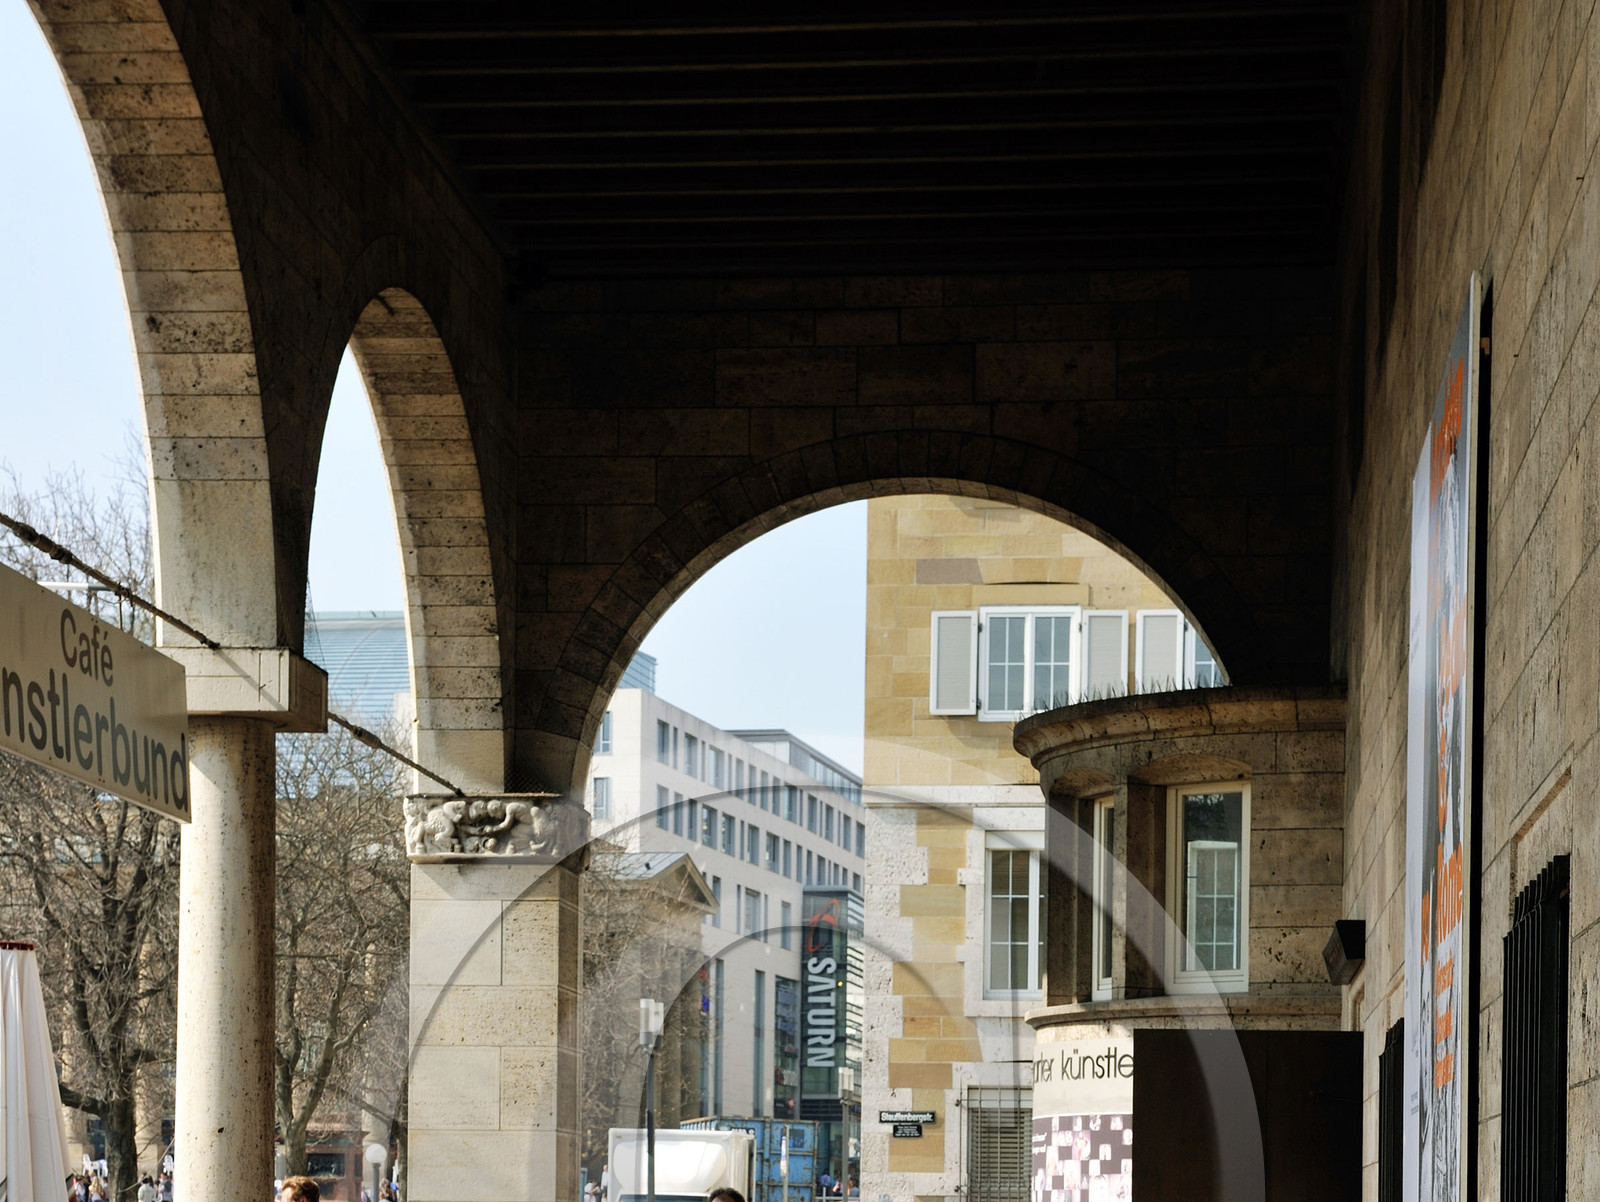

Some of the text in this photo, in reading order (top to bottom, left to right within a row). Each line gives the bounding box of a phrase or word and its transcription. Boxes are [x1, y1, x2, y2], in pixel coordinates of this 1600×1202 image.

[60, 608, 114, 687] Café
[1, 667, 190, 813] nstlerbund
[807, 956, 837, 1068] SATURN
